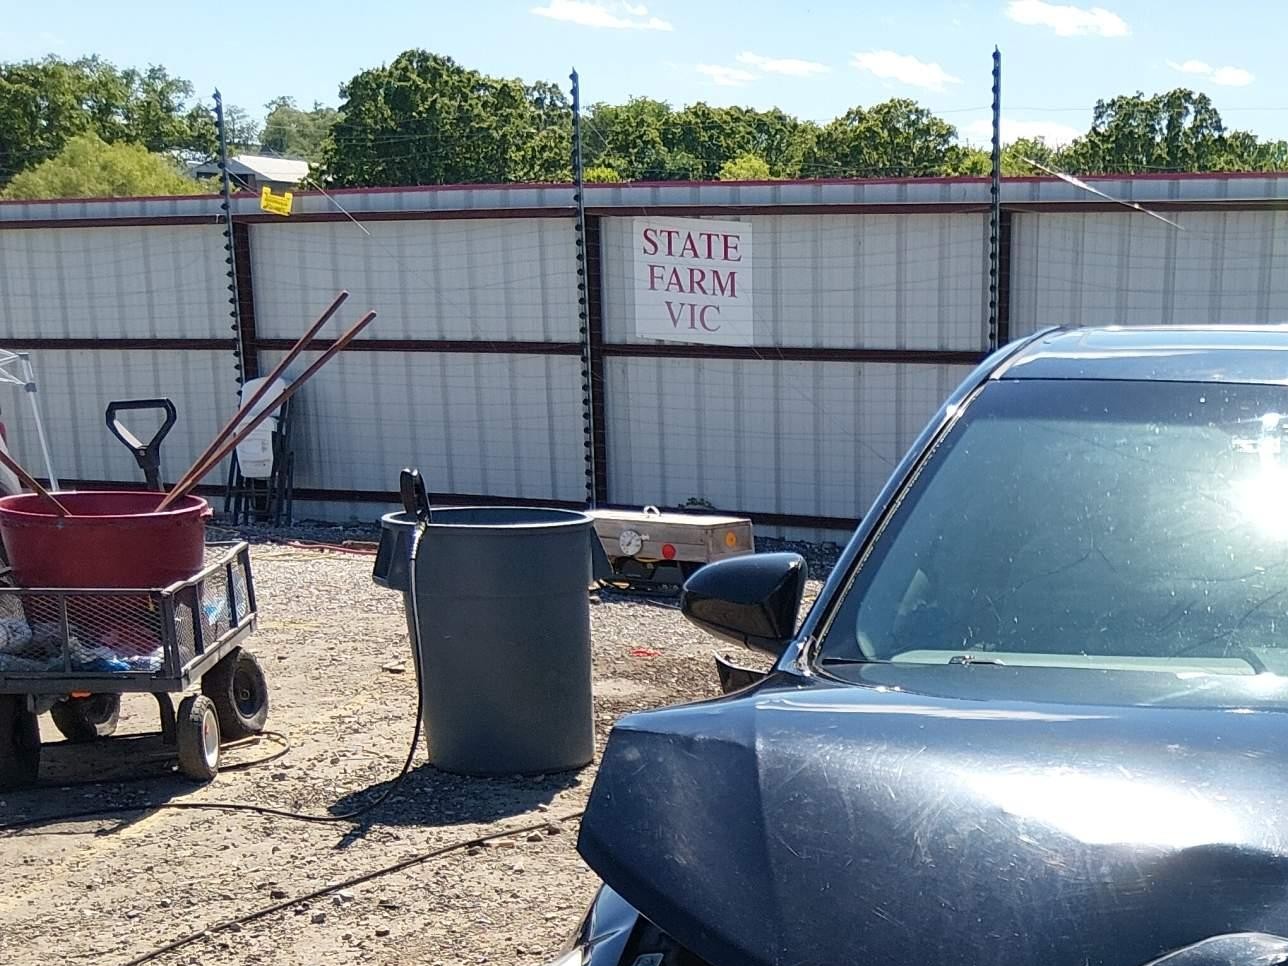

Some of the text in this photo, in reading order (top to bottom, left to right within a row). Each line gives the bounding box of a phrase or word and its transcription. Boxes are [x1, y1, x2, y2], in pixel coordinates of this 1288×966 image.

[643, 228, 742, 262] STATE
[647, 264, 738, 298] FARM
[664, 301, 721, 332] VIC
